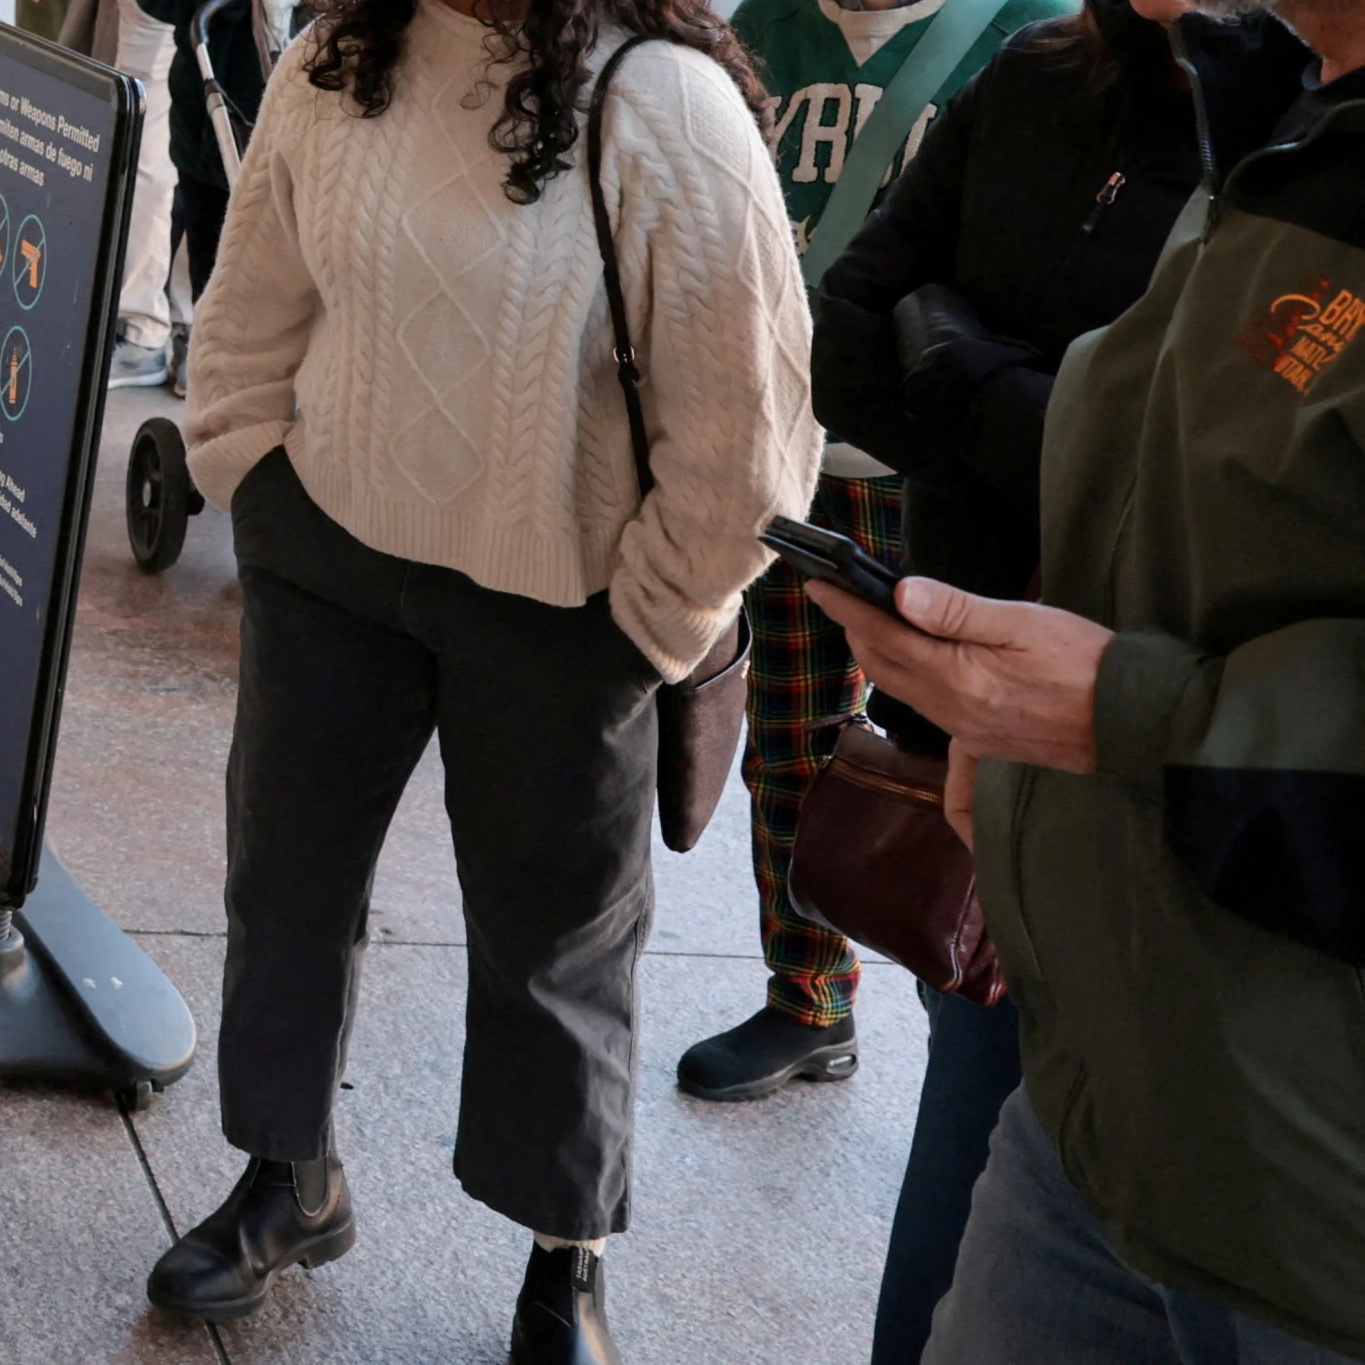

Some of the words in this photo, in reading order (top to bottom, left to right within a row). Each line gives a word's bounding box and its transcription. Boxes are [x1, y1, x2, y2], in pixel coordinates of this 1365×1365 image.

[10, 96, 20, 111] or
[20, 96, 57, 131] Weapons
[57, 115, 101, 153] Permitted
[19, 131, 44, 156] armas
[45, 142, 57, 163] de
[57, 148, 83, 177] fuego
[83, 163, 94, 182] ni
[19, 161, 45, 187] armas
[5, 475, 25, 503] Ahead
